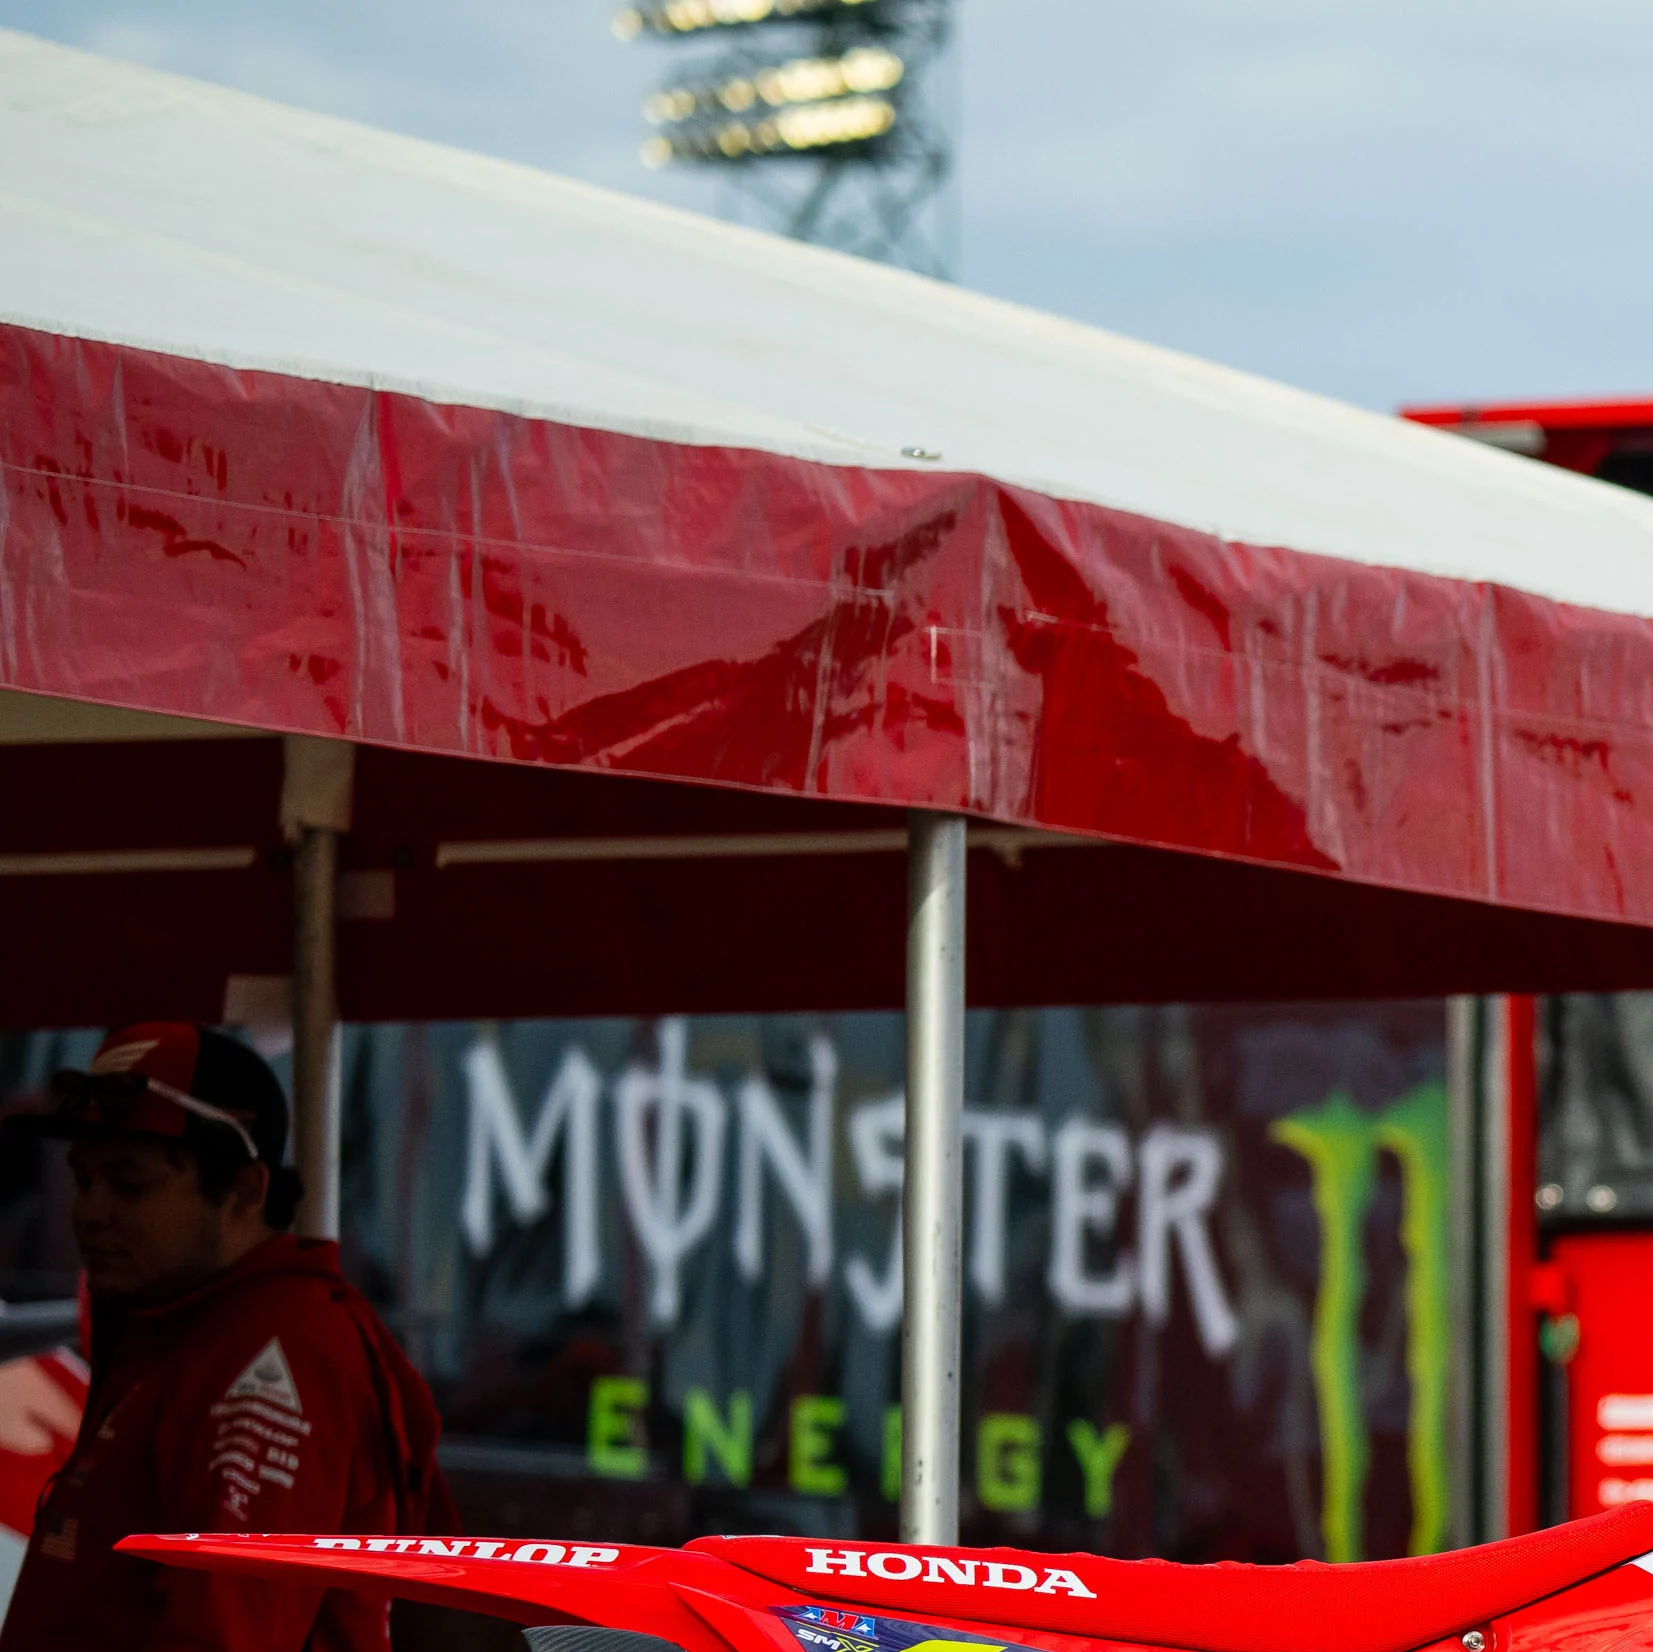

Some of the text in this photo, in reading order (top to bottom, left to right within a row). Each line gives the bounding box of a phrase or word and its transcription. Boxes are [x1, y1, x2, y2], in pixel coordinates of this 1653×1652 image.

[590, 1377, 1130, 1518] ENEGY
[805, 1548, 1097, 1598] HONDA
[797, 1606, 878, 1640] AMA
